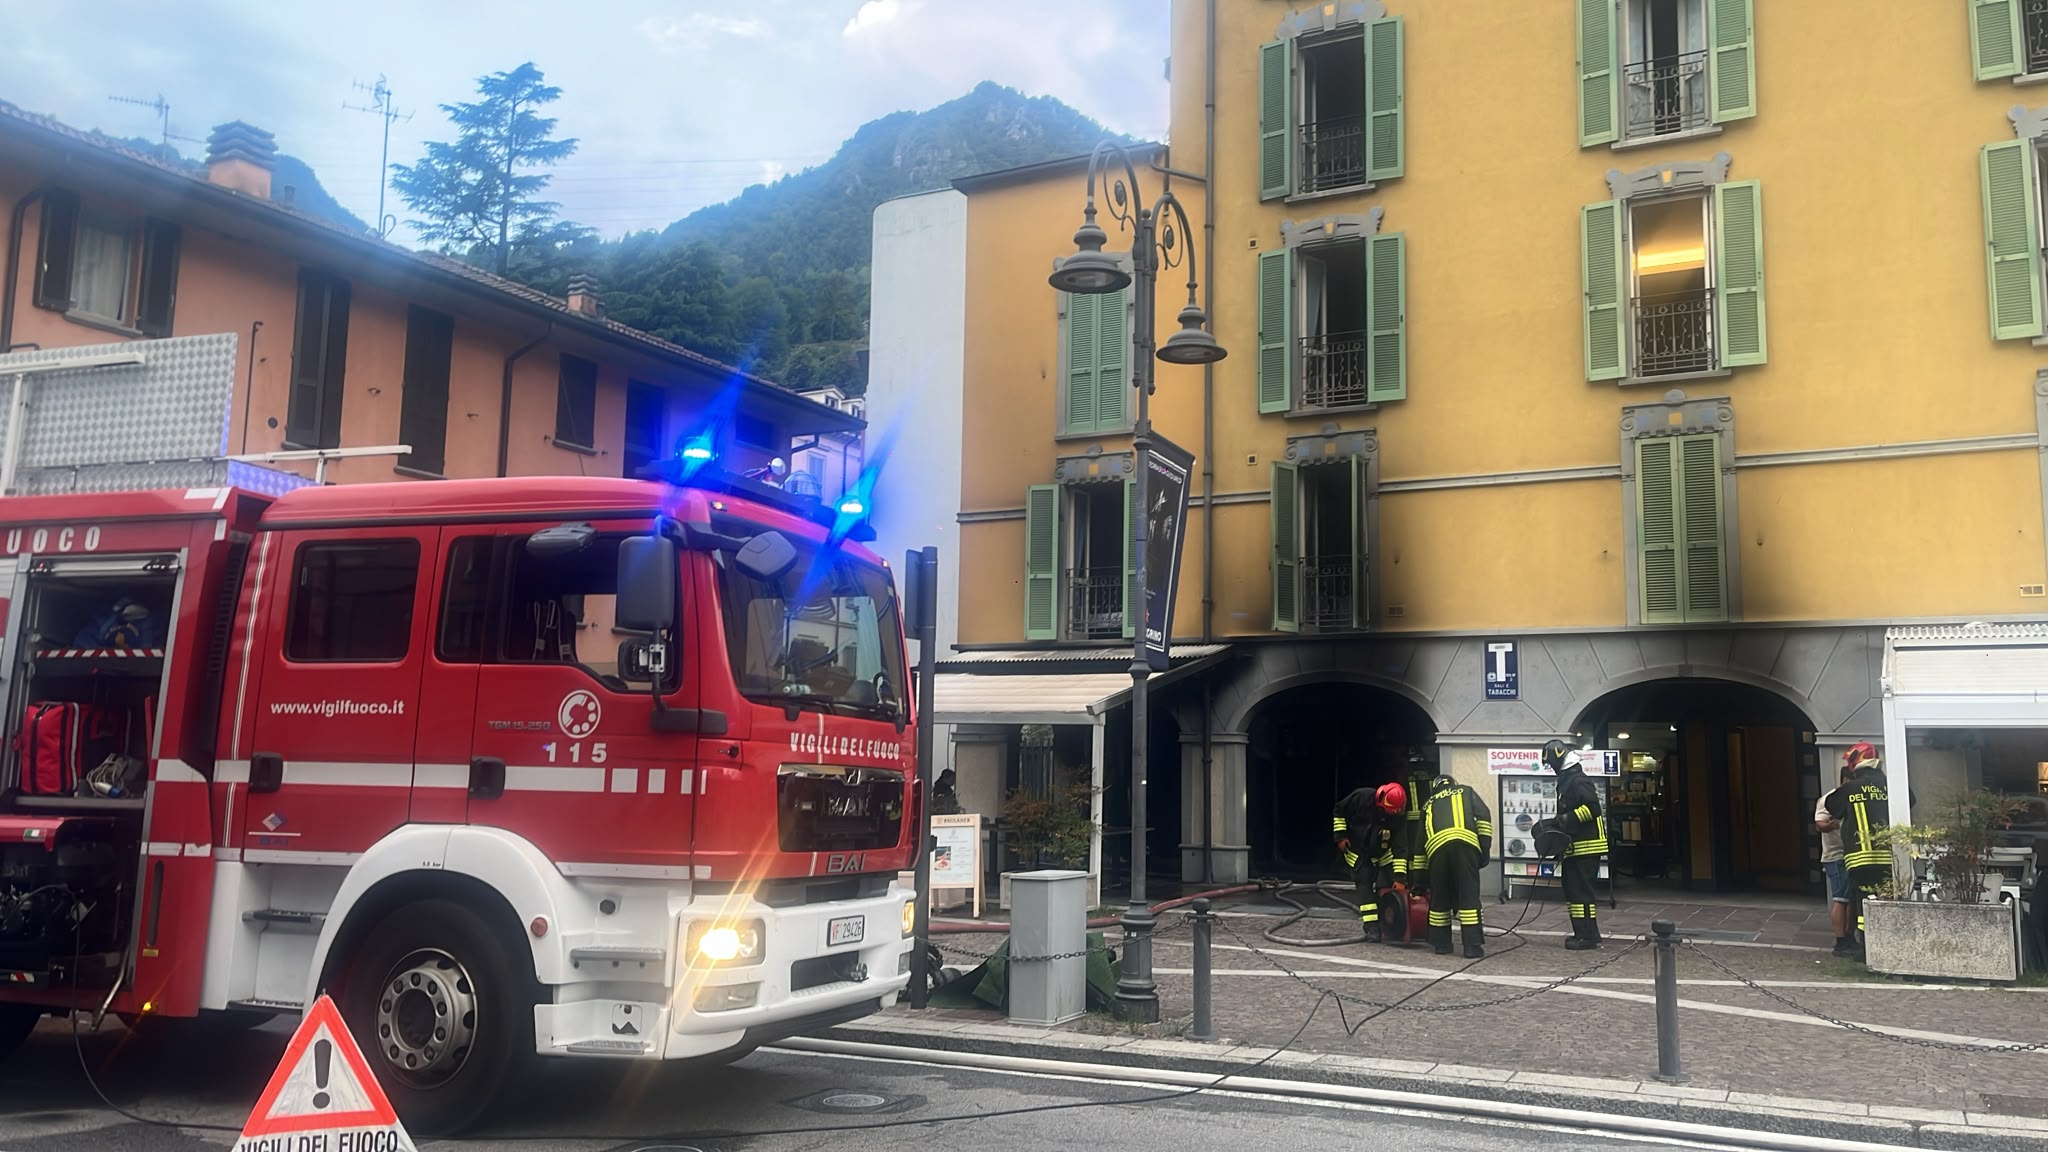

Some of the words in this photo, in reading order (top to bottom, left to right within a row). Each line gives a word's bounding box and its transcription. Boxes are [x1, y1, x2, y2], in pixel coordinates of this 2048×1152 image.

[1488, 688, 1516, 696] TABACCHI
[270, 699, 405, 718] www.vigilfuoco.it
[790, 732, 837, 755] VIGILI
[840, 736, 865, 757] DEL
[866, 739, 900, 761] FUOCO
[1490, 750, 1540, 761] SOUVENIR
[1848, 793, 1868, 803] DEL
[1870, 793, 1889, 801] FUO
[826, 852, 867, 874] BAI
[842, 920, 862, 939] 29426
[338, 1130, 399, 1152] FUOCO
